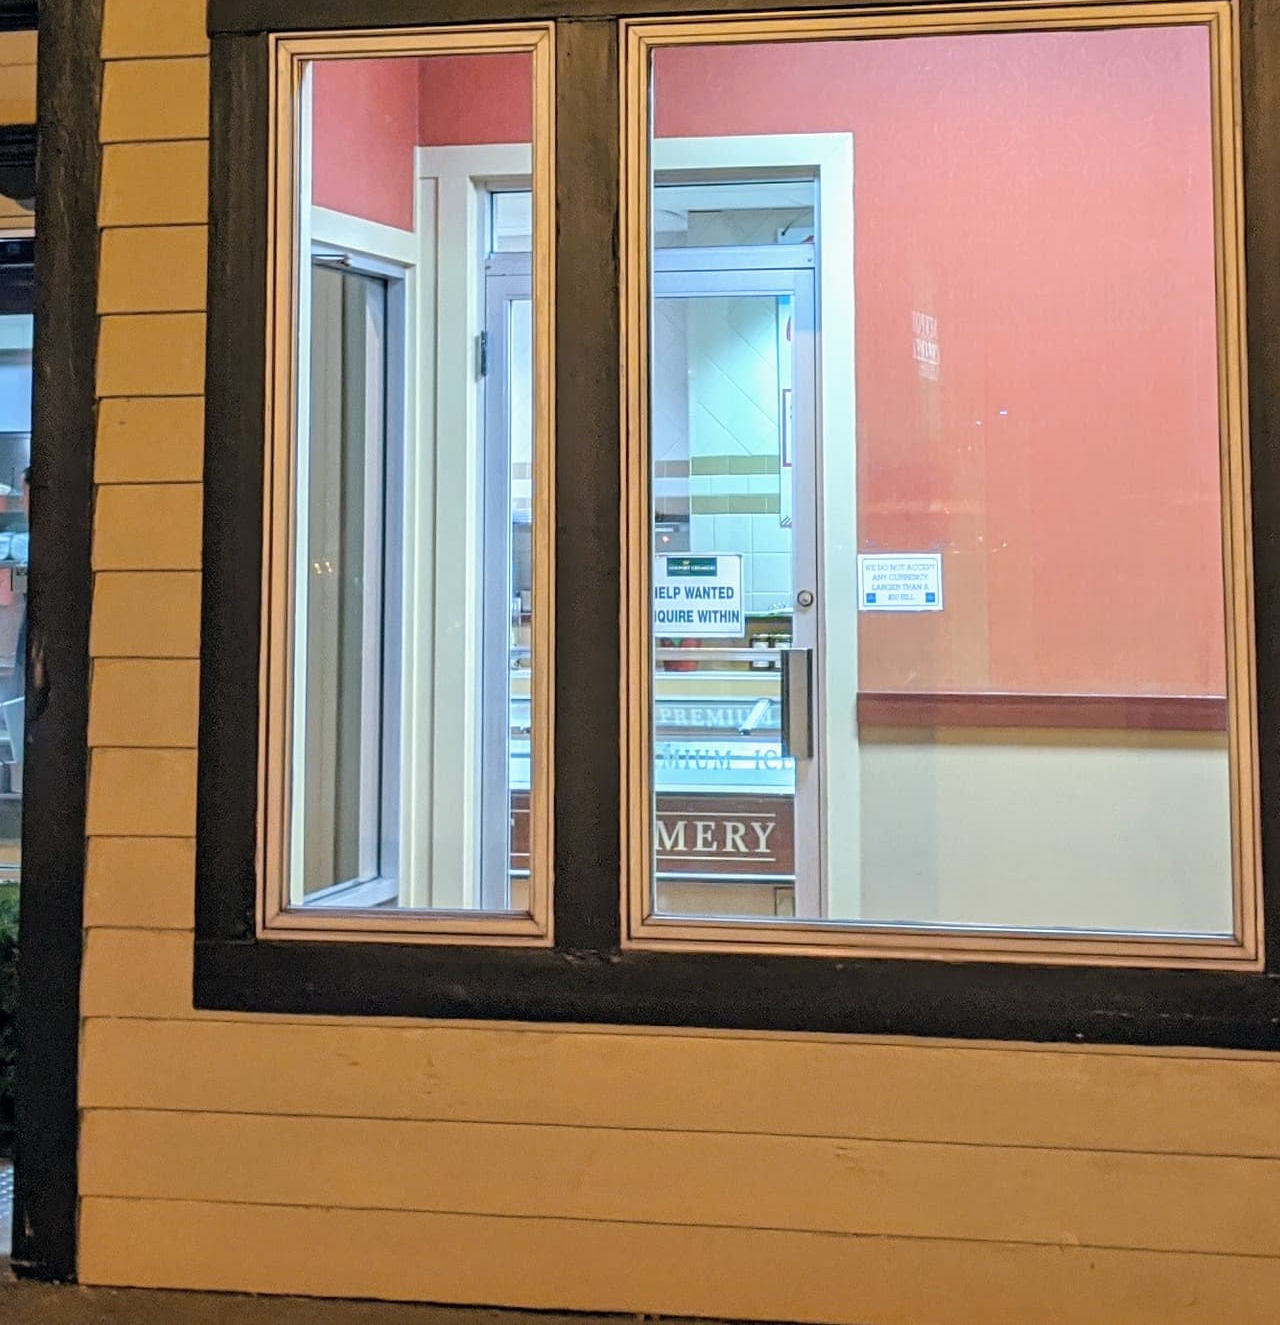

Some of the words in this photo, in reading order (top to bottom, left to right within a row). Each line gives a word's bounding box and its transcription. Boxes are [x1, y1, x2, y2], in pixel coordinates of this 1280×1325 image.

[684, 586, 735, 600] WANTED
[697, 609, 740, 624] WITHIN
[655, 820, 776, 854] MERY
